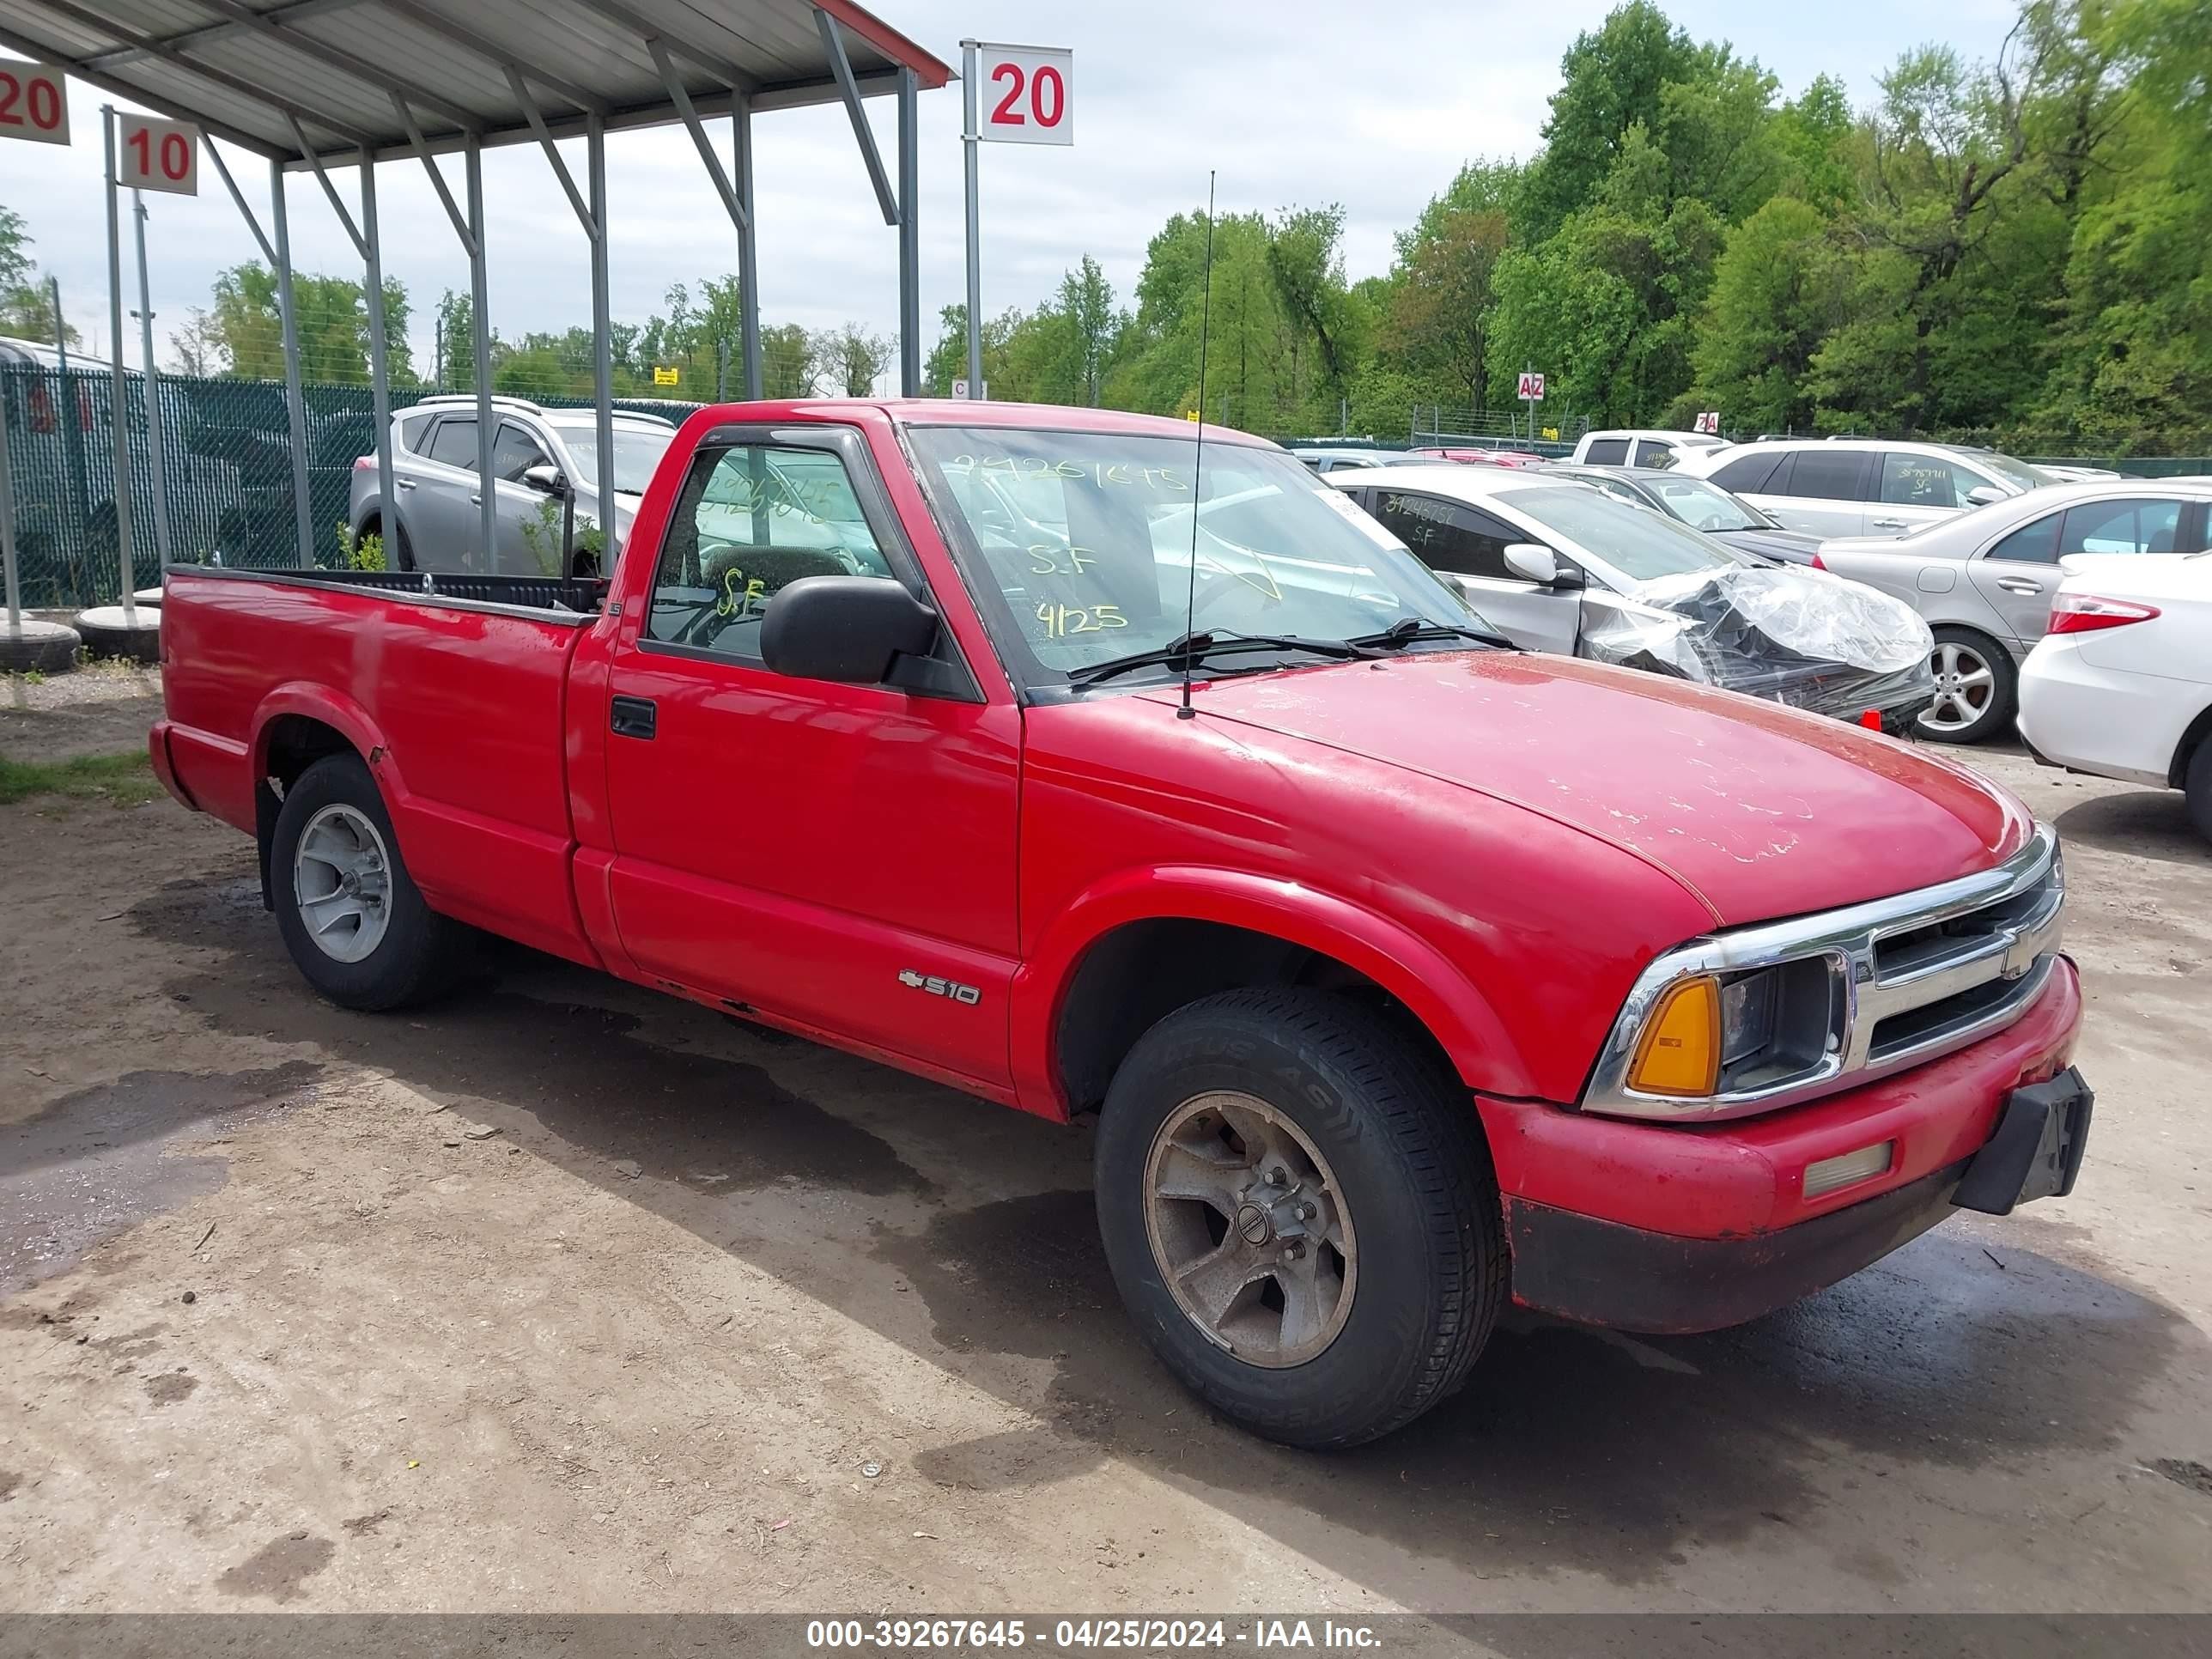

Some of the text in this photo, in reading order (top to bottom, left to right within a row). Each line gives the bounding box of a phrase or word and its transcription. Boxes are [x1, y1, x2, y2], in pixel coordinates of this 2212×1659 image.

[0, 72, 60, 130] 20
[990, 62, 1064, 128] 20
[129, 128, 189, 180] 10
[924, 976, 981, 1006] S10
